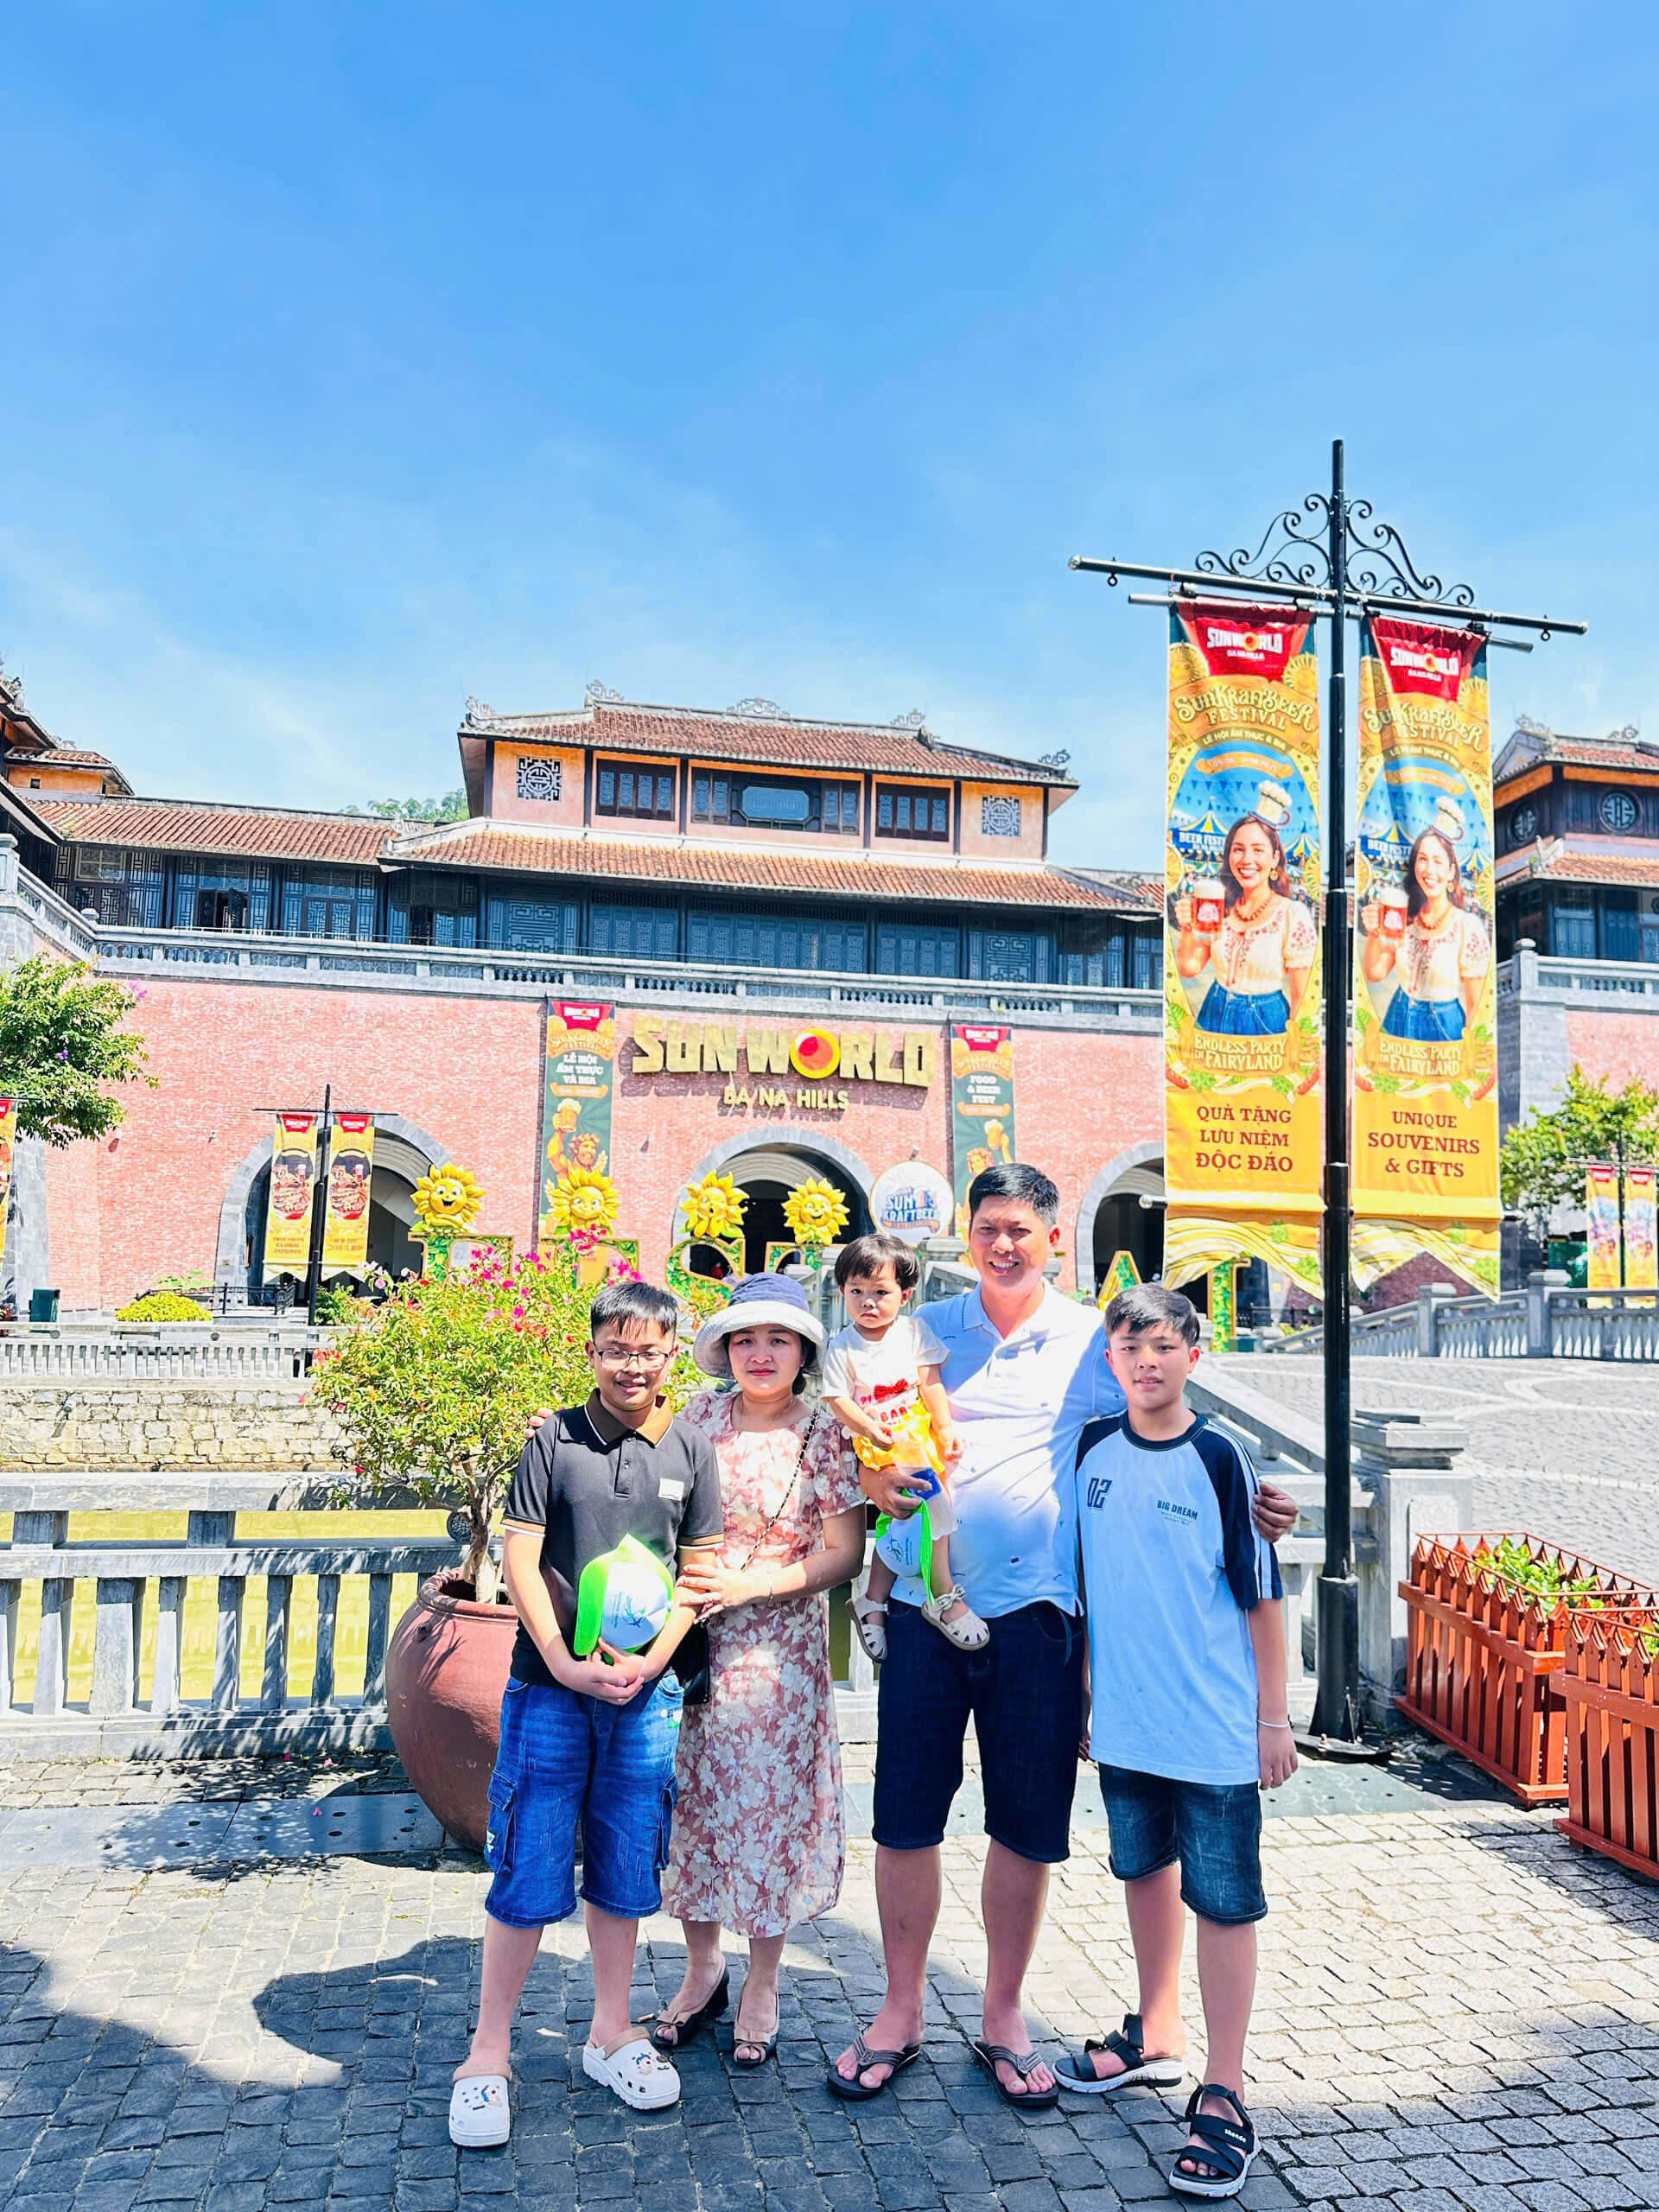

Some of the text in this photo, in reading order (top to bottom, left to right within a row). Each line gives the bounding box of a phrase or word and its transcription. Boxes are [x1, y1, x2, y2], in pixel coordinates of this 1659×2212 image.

[1205, 707, 1287, 731] FESTIVAL
[632, 1015, 938, 1088] SUN WORLD
[1195, 1037, 1287, 1056] ENDLESS PARTY
[1205, 1051, 1284, 1071] FAIRYLAND
[759, 1087, 790, 1108] NA
[797, 1089, 849, 1110] HILLS
[1197, 1103, 1292, 1125] QUÀ TẶNG
[1392, 1110, 1457, 1129] UNIQUE
[1199, 1128, 1289, 1149] LƯU NIỆM
[1368, 1132, 1480, 1154] SOUVENIRS
[1196, 1148, 1294, 1173] ĐỘC ĐÁO
[1385, 1158, 1465, 1178] & GIFTS
[885, 1194, 913, 1211] SUN
[1087, 1477, 1113, 1509] 02
[1157, 1499, 1171, 1511] BIG
[1172, 1503, 1198, 1521] DREAM
